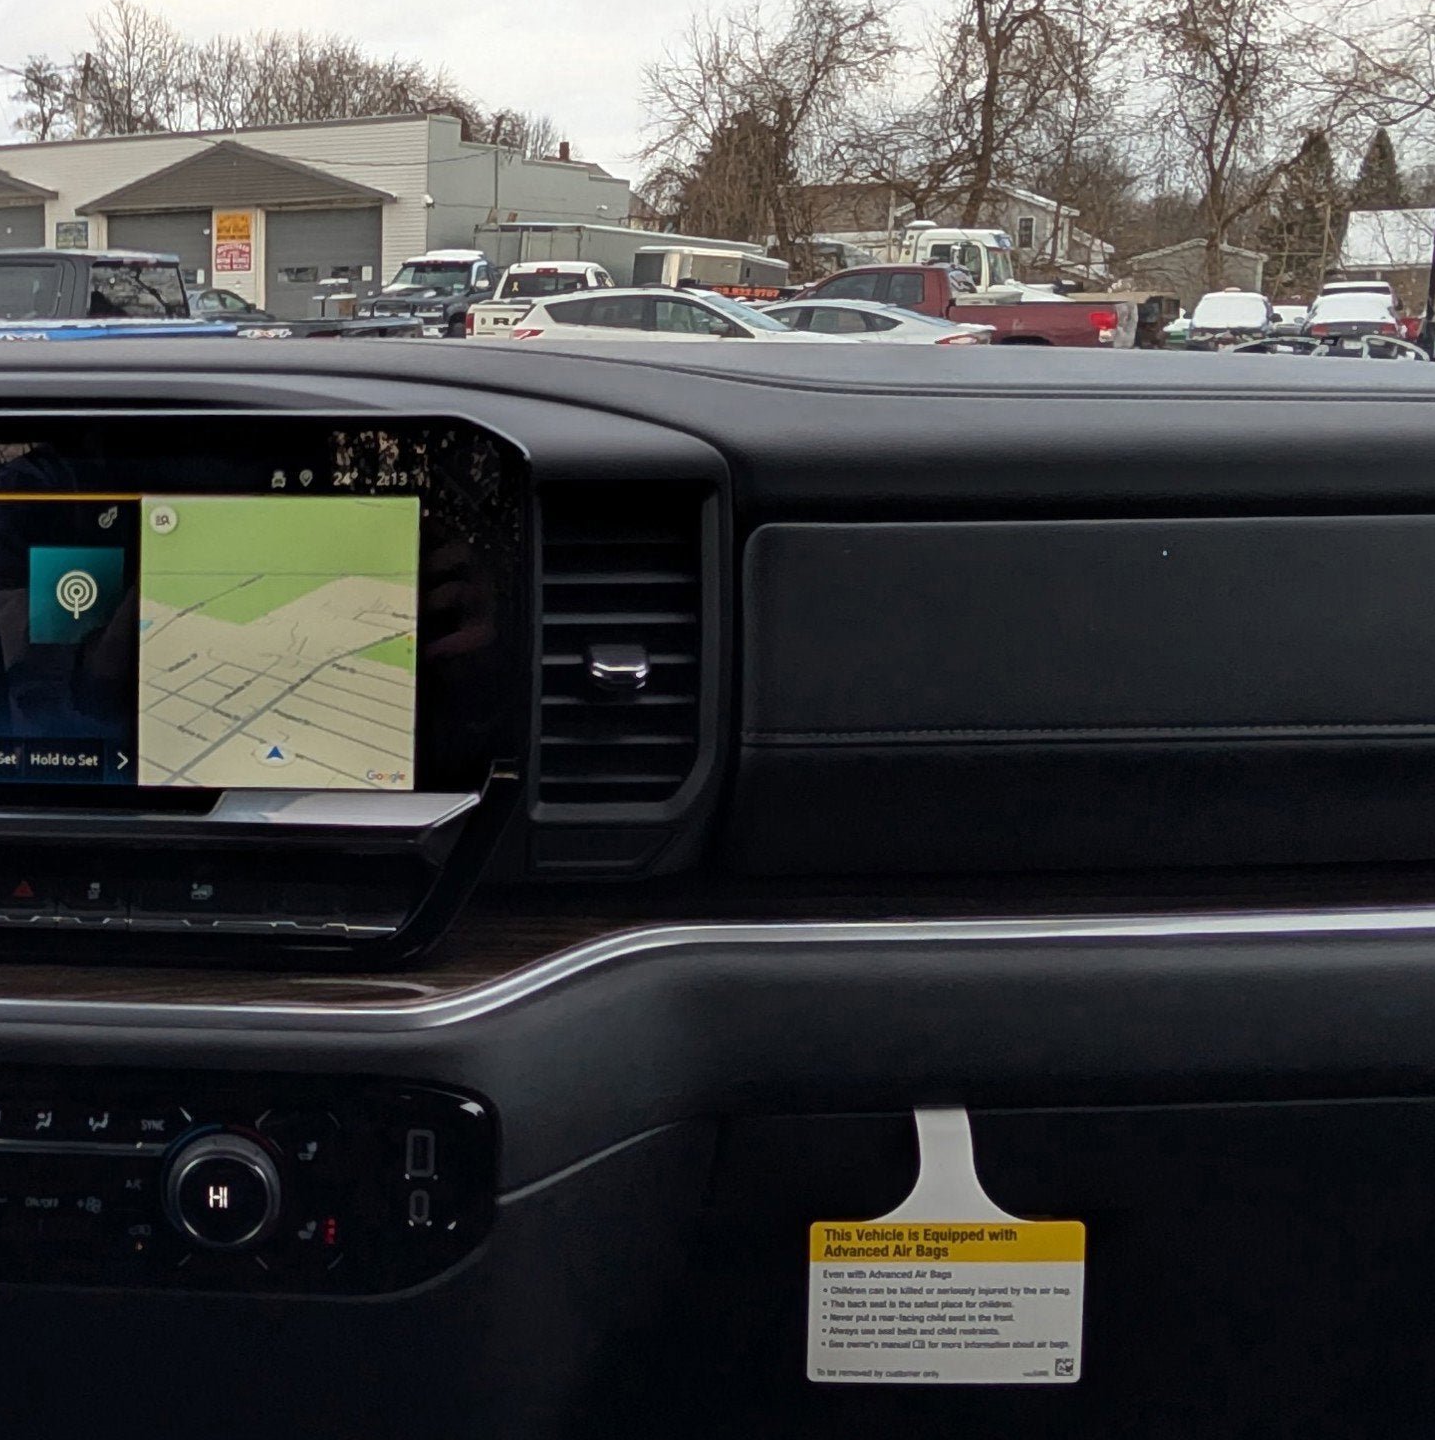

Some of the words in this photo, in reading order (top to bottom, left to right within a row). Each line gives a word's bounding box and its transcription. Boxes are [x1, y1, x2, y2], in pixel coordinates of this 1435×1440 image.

[31, 754, 60, 766] Hold
[62, 754, 75, 766] to
[79, 754, 99, 767] Set
[366, 769, 406, 783] Google
[140, 1118, 165, 1132] SYNC
[208, 1185, 229, 1210] HI
[824, 1229, 851, 1241] This
[856, 1229, 903, 1241] Vehicle
[908, 1229, 919, 1241] is
[923, 1229, 984, 1244] Equipped
[988, 1229, 1017, 1241] with
[824, 1245, 889, 1257] Advanced
[893, 1245, 912, 1257] Air
[916, 1245, 949, 1259] Bags
[823, 1270, 844, 1279] Even
[848, 1270, 866, 1279] with
[869, 1270, 913, 1279] Advanced
[915, 1270, 928, 1279] Air
[930, 1270, 952, 1280] Bags
[1011, 1287, 1020, 1295] by
